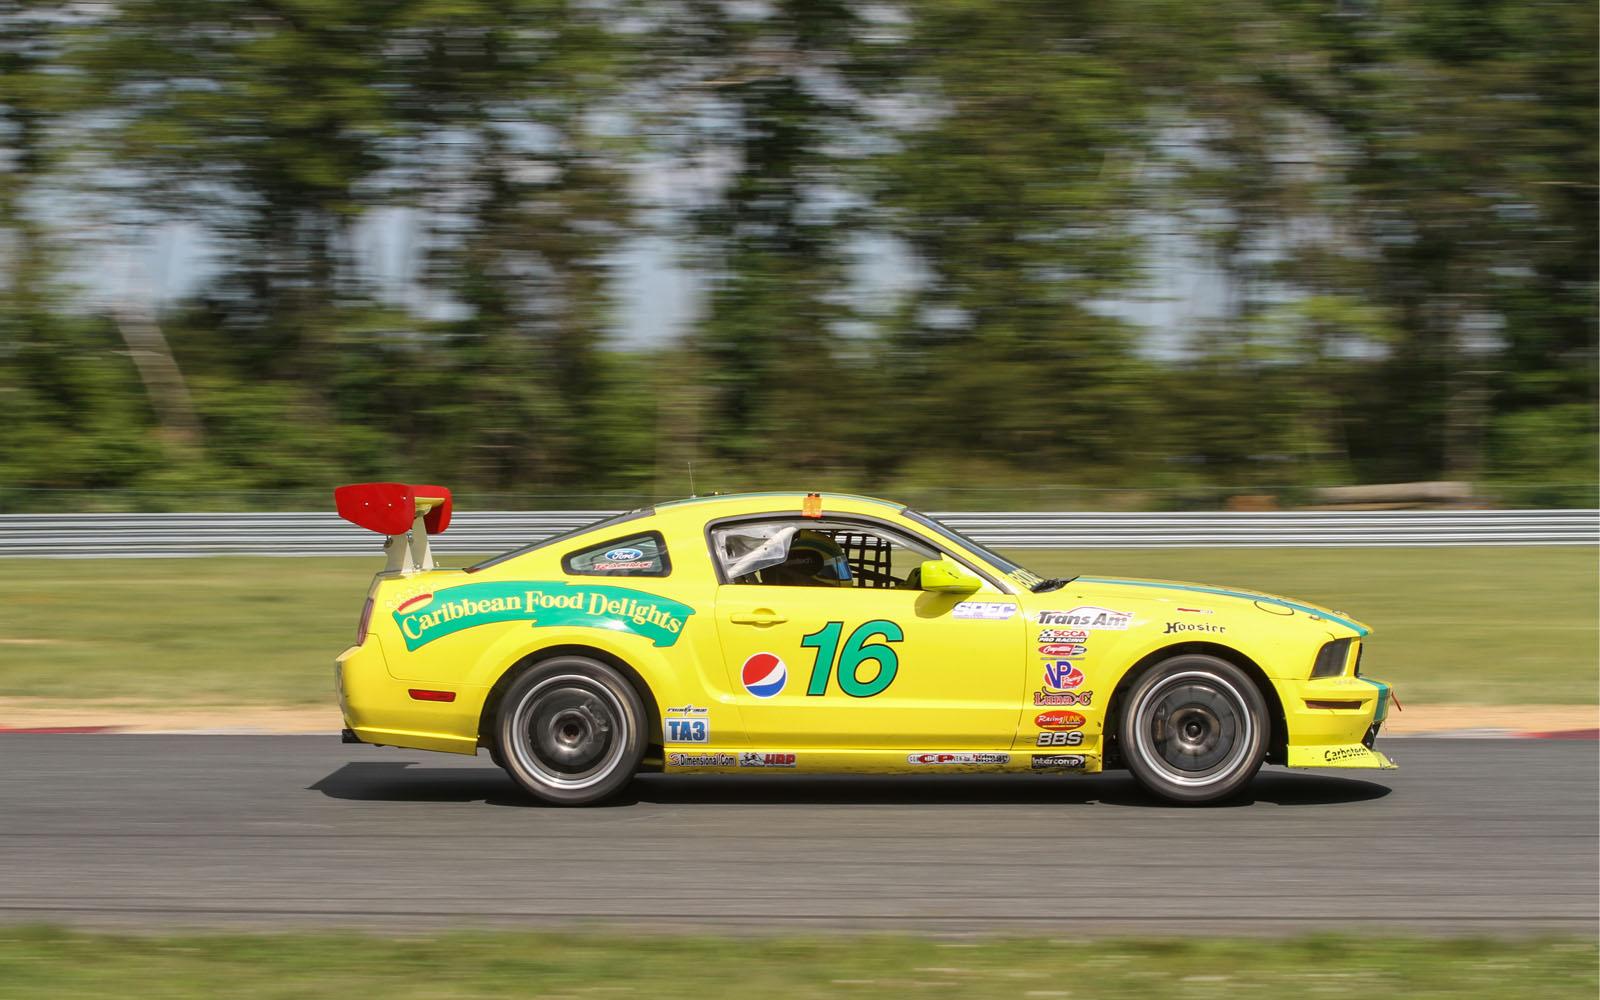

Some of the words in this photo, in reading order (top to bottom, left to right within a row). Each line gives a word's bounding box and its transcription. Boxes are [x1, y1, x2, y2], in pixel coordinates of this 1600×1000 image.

[611, 551, 636, 561] Ford
[402, 593, 521, 641] Caribbean
[524, 590, 584, 614] Food
[587, 592, 682, 634] Delights
[1038, 611, 1091, 625] Trans
[1093, 613, 1128, 626] Am
[1164, 621, 1227, 635] Hoosier
[800, 619, 905, 698] 16
[1046, 660, 1072, 689] VP
[669, 721, 705, 741] TA3
[1037, 731, 1084, 746] BBS
[764, 754, 796, 765] HRP
[1033, 755, 1080, 766] Intercomp
[1324, 746, 1369, 763] Carbotech
